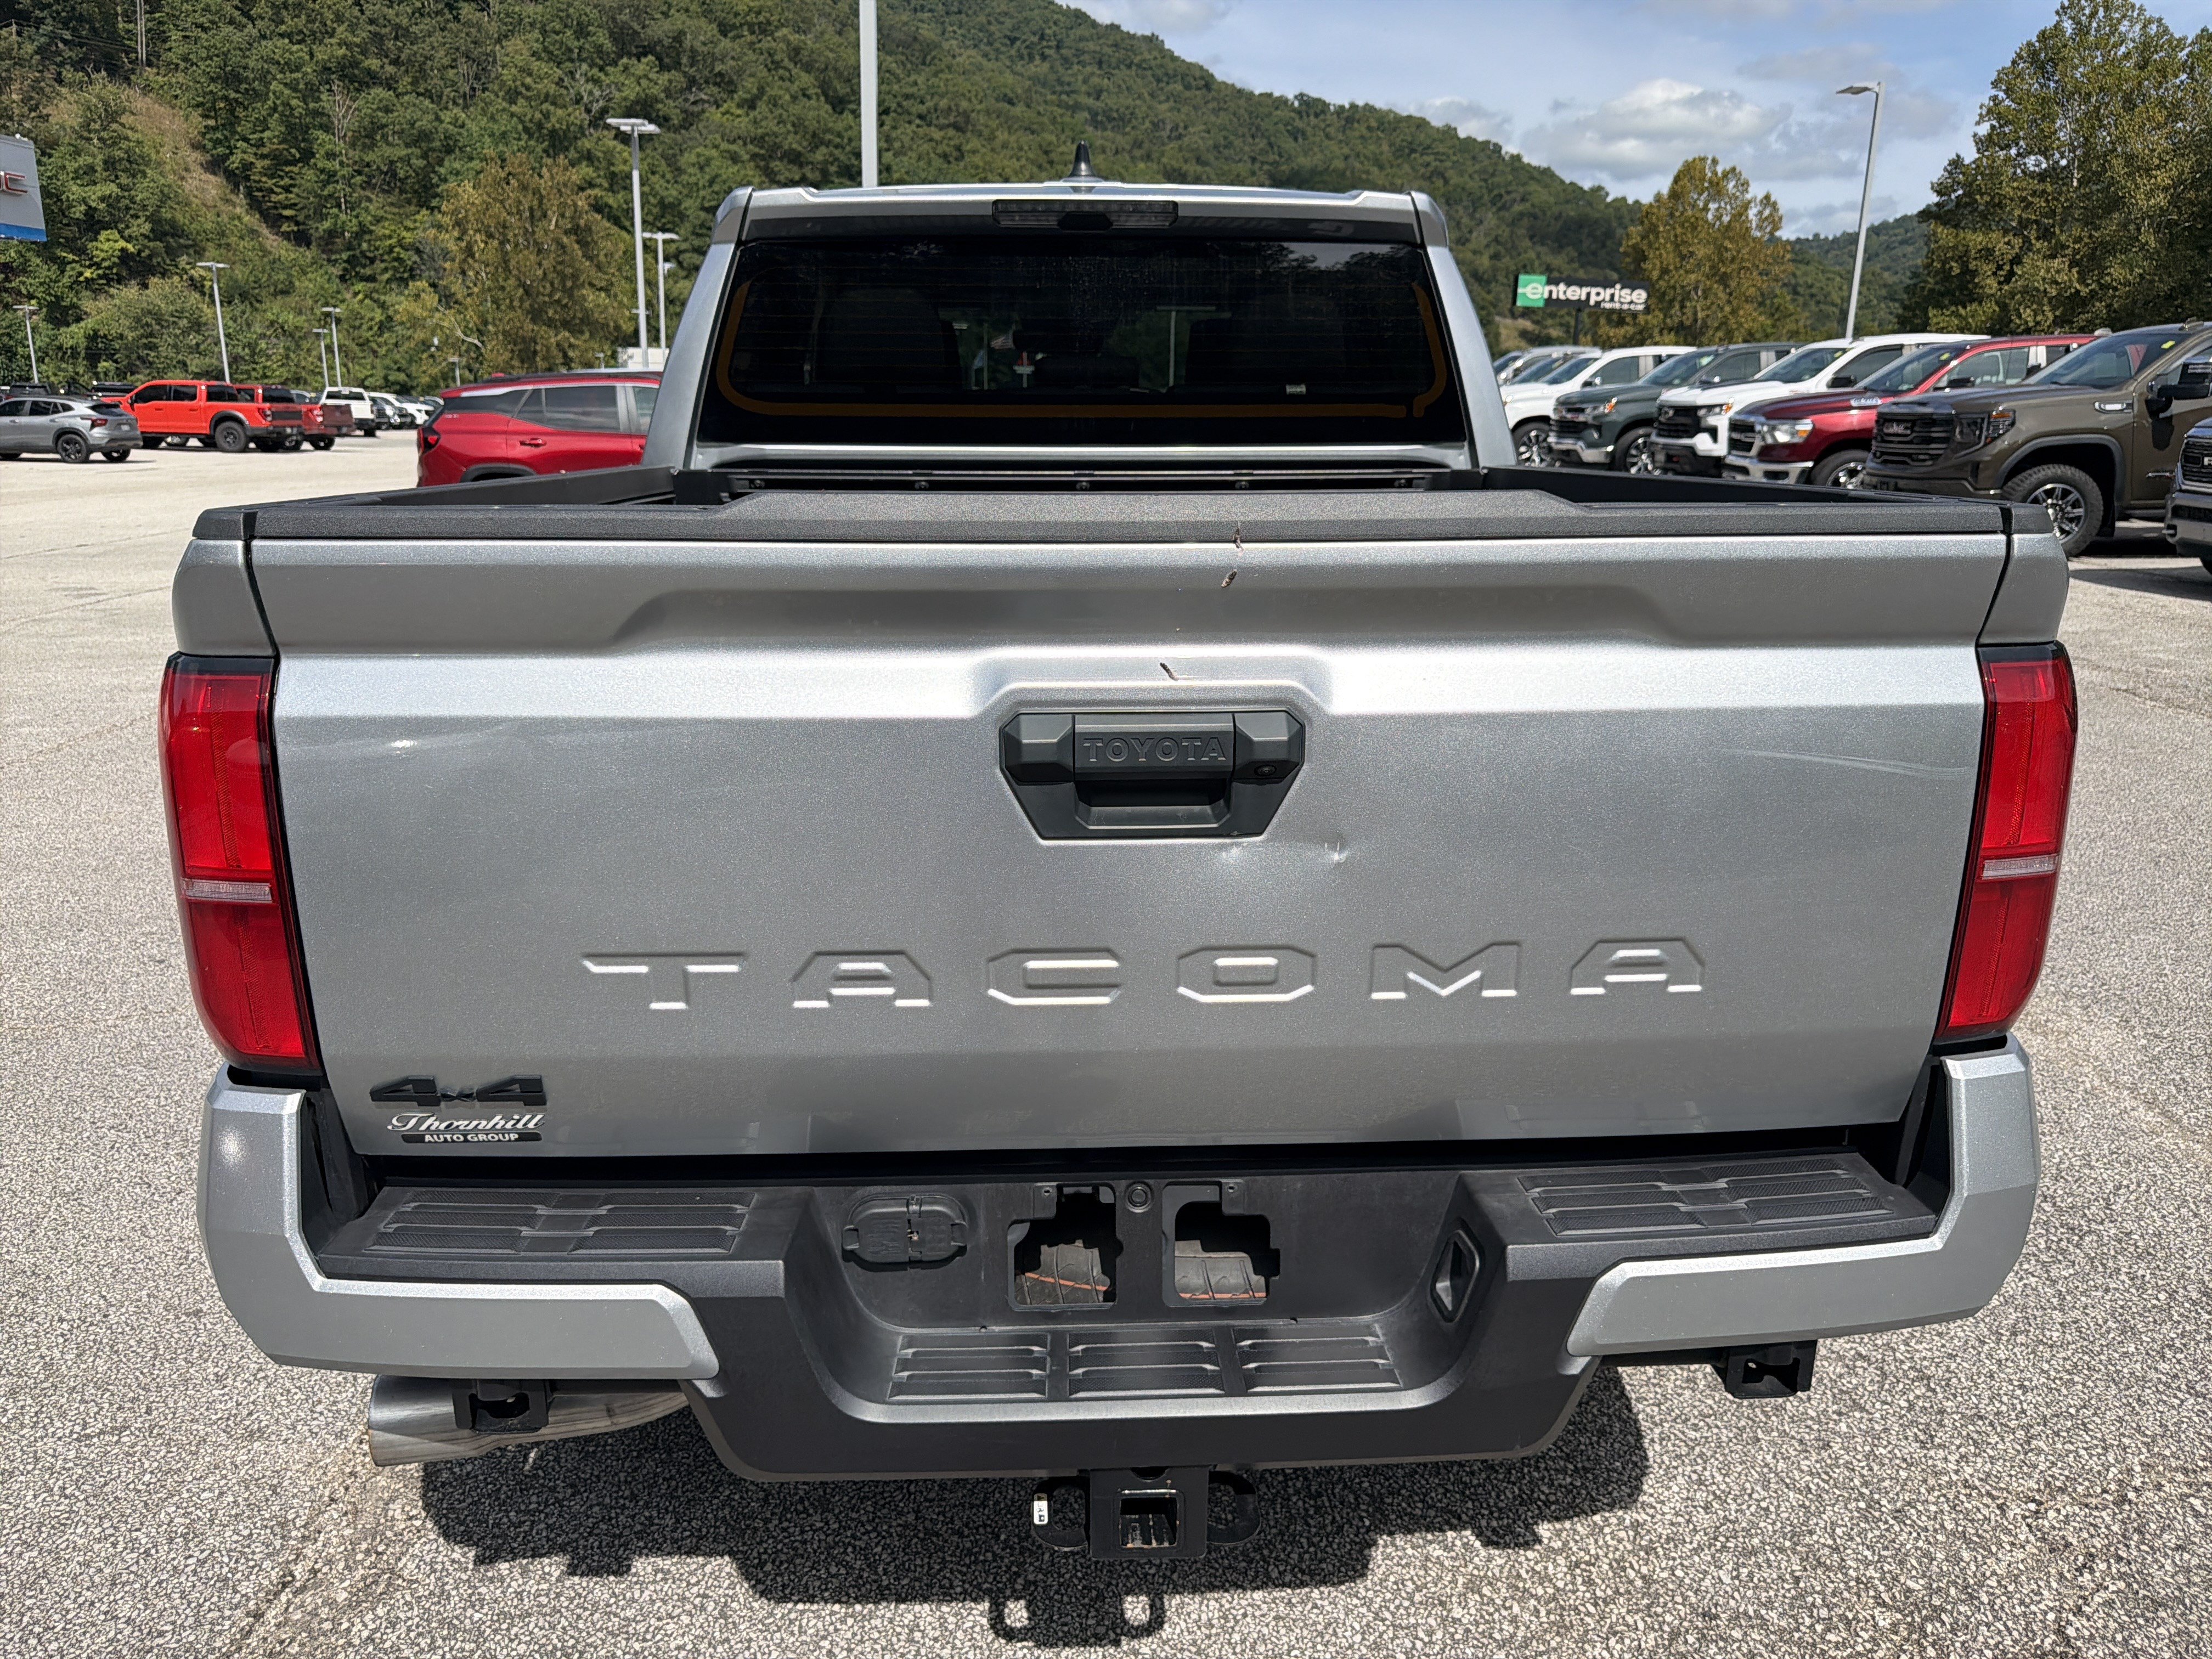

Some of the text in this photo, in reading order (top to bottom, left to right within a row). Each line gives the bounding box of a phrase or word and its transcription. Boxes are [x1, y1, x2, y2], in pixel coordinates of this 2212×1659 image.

[1518, 282, 1647, 306] enterprise
[1083, 737, 1226, 761] TOYOTA
[582, 938, 1705, 1011] TACOMA
[387, 1111, 545, 1131] Thornhill
[425, 1133, 519, 1143] AUTO GROUP
